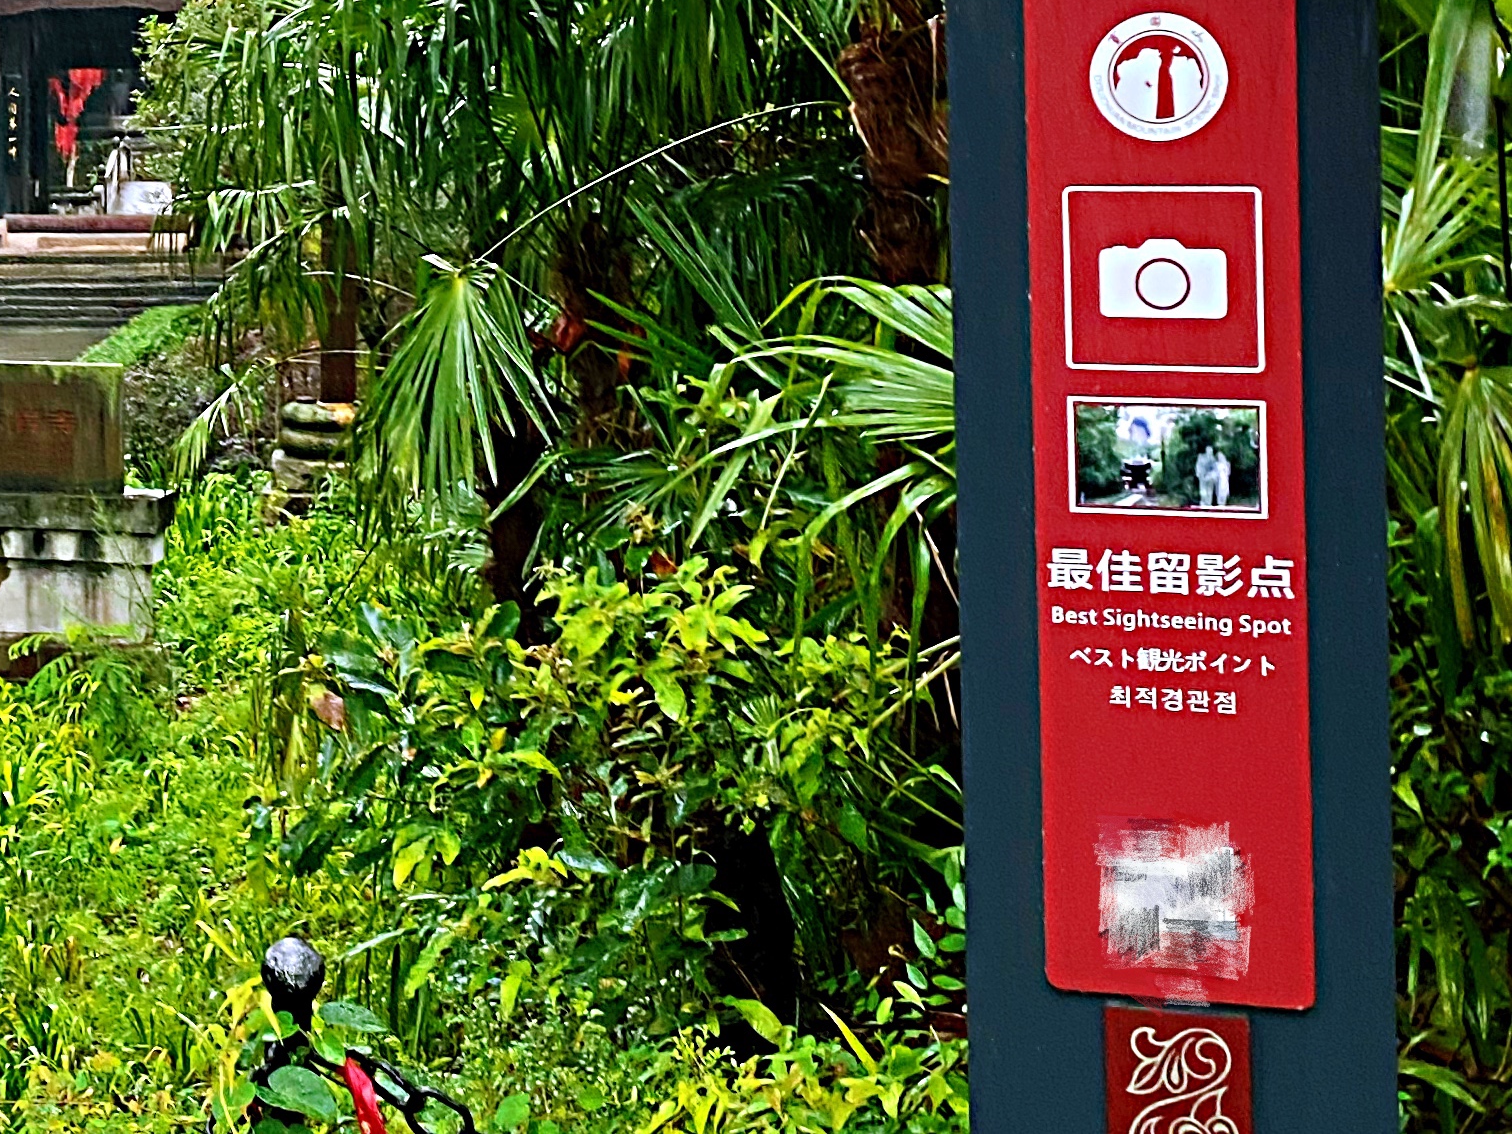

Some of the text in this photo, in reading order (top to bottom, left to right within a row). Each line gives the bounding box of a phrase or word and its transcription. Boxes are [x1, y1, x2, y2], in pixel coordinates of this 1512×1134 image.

[1047, 548, 1295, 599] 最佳留影点
[1052, 606, 1292, 638] Best Sightseeing Spot
[1070, 647, 1275, 676] ベスト観光ポイント
[1109, 686, 1236, 715] 최적경관점
